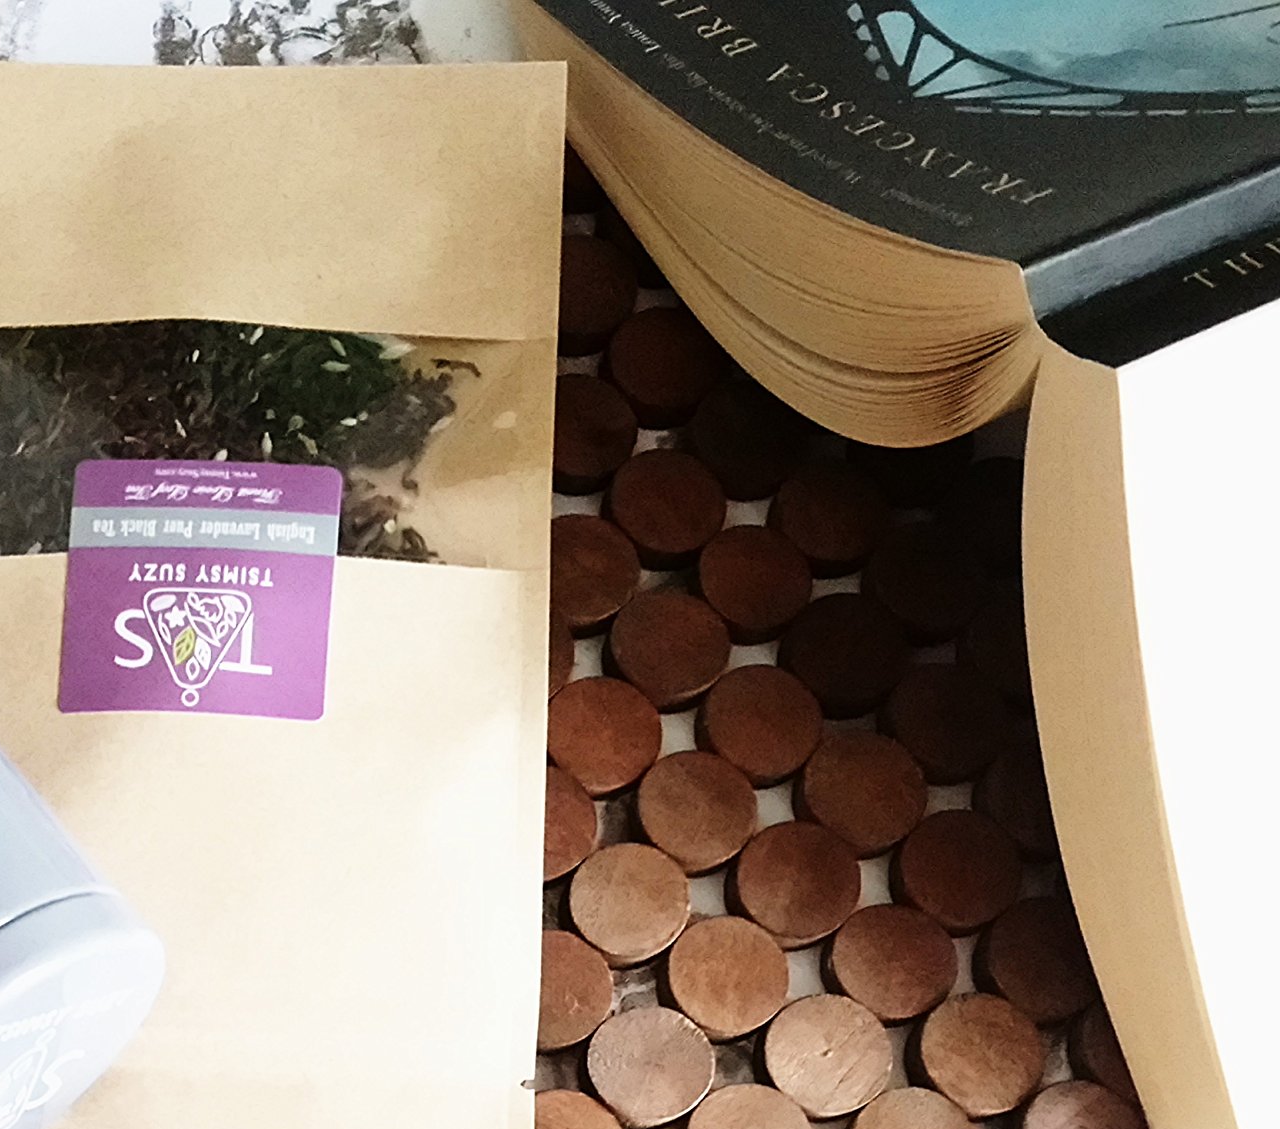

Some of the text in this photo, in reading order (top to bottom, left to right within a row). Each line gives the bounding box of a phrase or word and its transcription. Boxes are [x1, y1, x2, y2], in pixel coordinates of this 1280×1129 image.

[621, 21, 661, 53] Louisa
[765, 62, 1055, 205] FRANCESCA
[124, 481, 284, 505] Finest Loose Leaf Tea
[92, 518, 317, 545] English Lavender Puer Black Tea
[128, 562, 274, 587] TSIMSY SUZY
